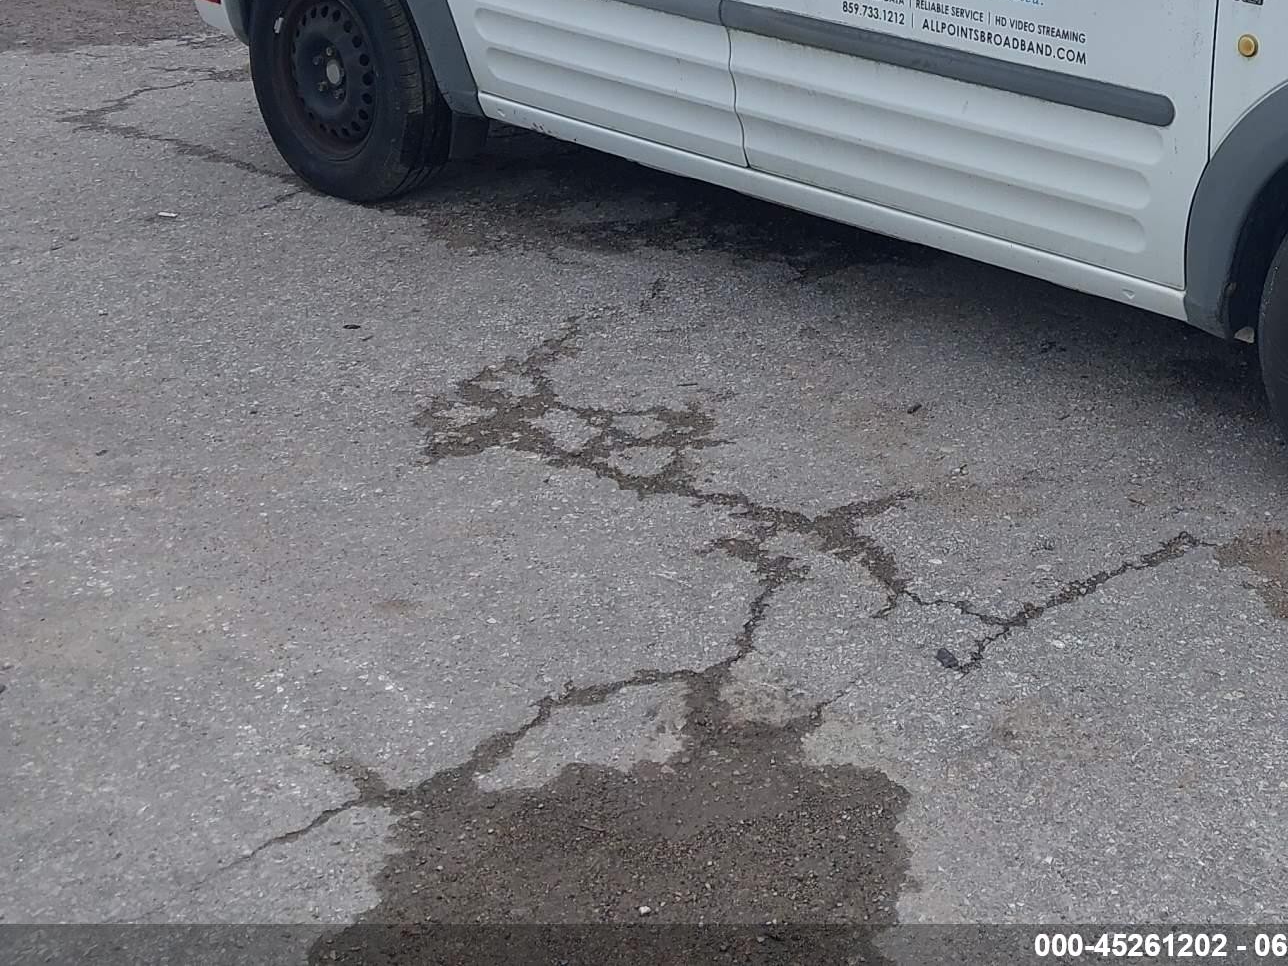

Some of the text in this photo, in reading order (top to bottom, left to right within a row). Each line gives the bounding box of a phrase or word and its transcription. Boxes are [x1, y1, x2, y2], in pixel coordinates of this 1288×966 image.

[843, 0, 1087, 65] 859.733.1212 ALLPOINTSBROADBAND.COM
[951, 6, 984, 23] SERVICE
[995, 15, 1007, 28] HD
[1010, 18, 1036, 33] VIDEO
[1038, 24, 1087, 44] STREAMING
